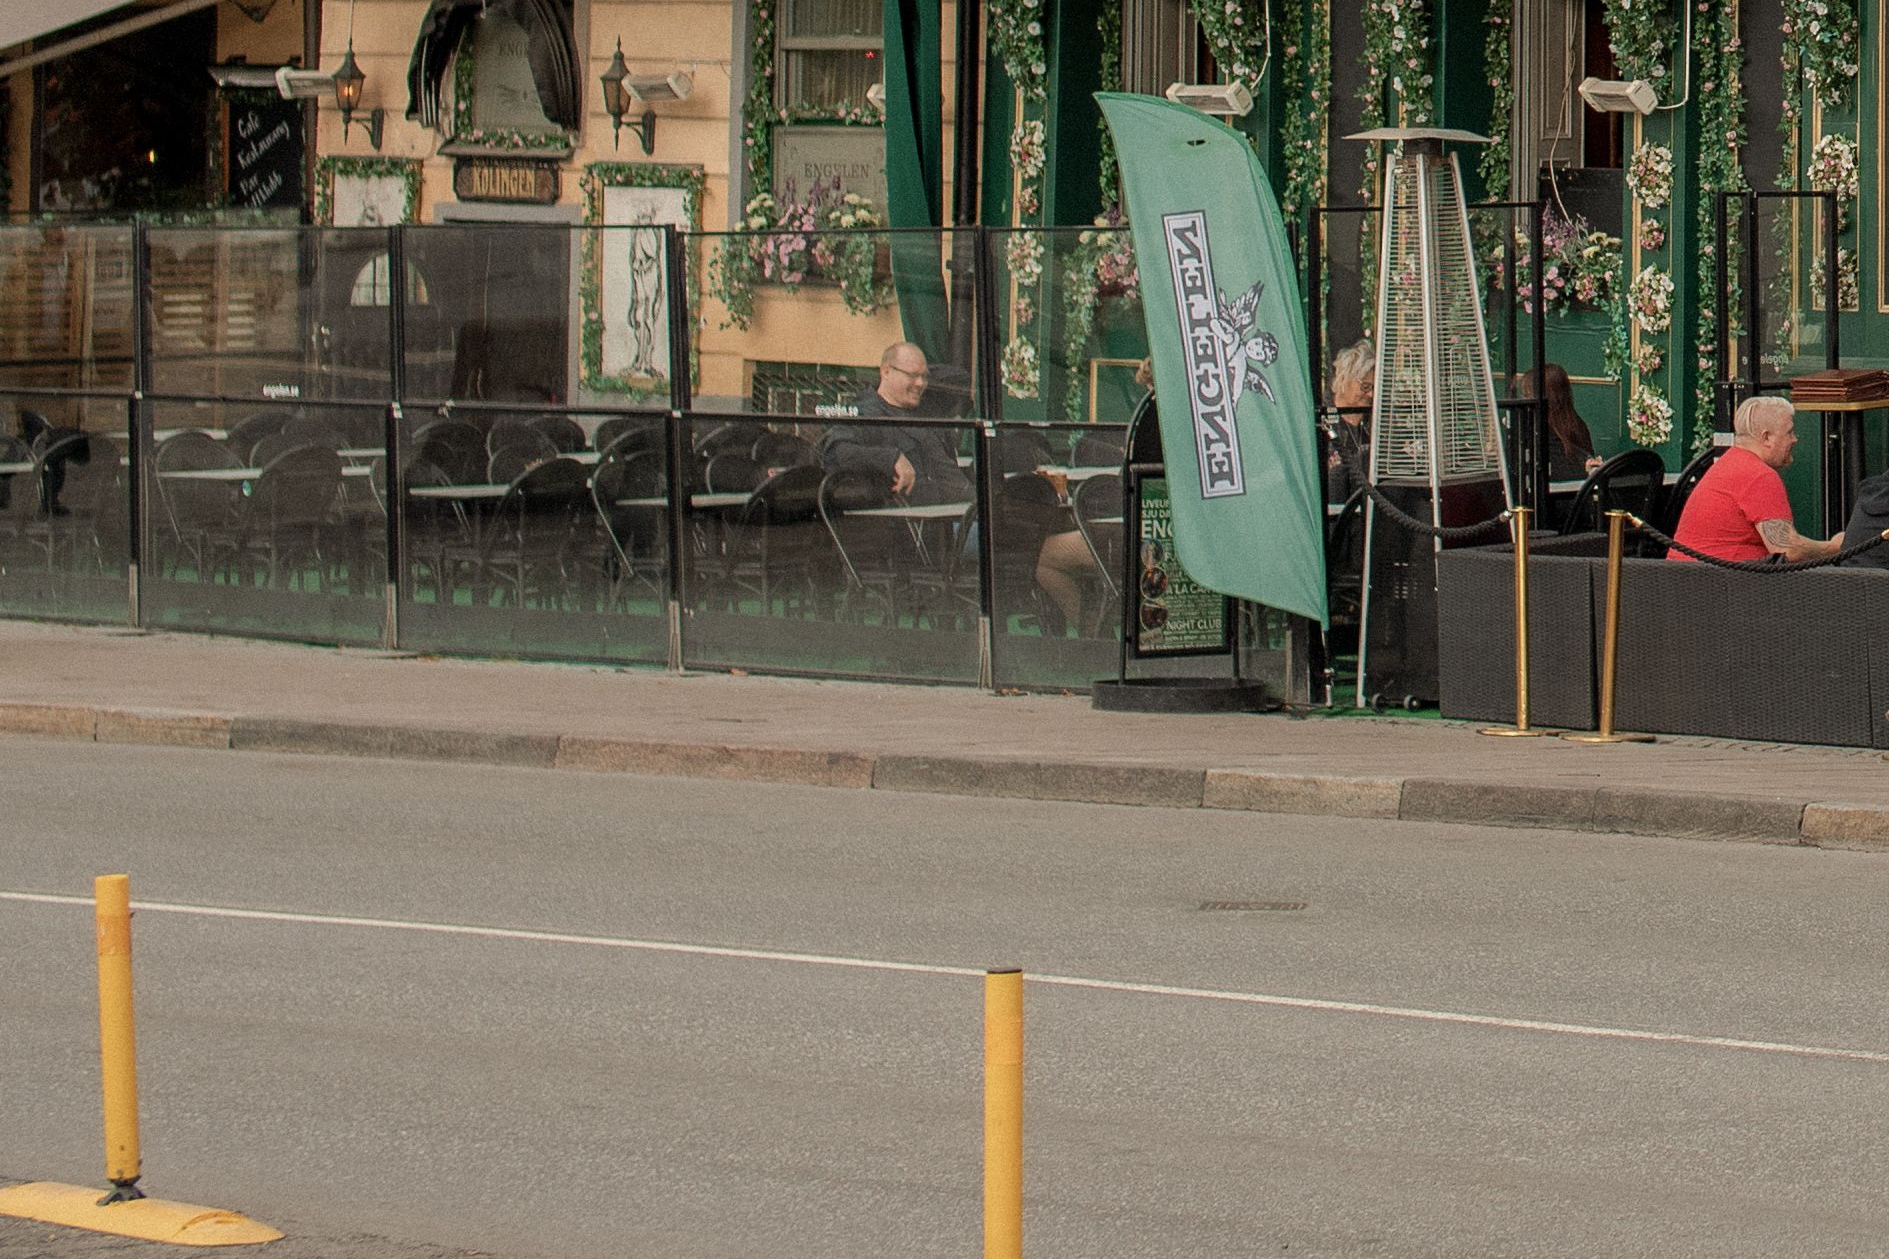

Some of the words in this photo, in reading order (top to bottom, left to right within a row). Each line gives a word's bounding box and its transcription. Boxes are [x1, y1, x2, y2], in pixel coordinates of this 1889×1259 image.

[472, 167, 537, 197] KOLINGEN
[1166, 620, 1196, 630] NIGHT
[1197, 619, 1222, 630] CLUB
